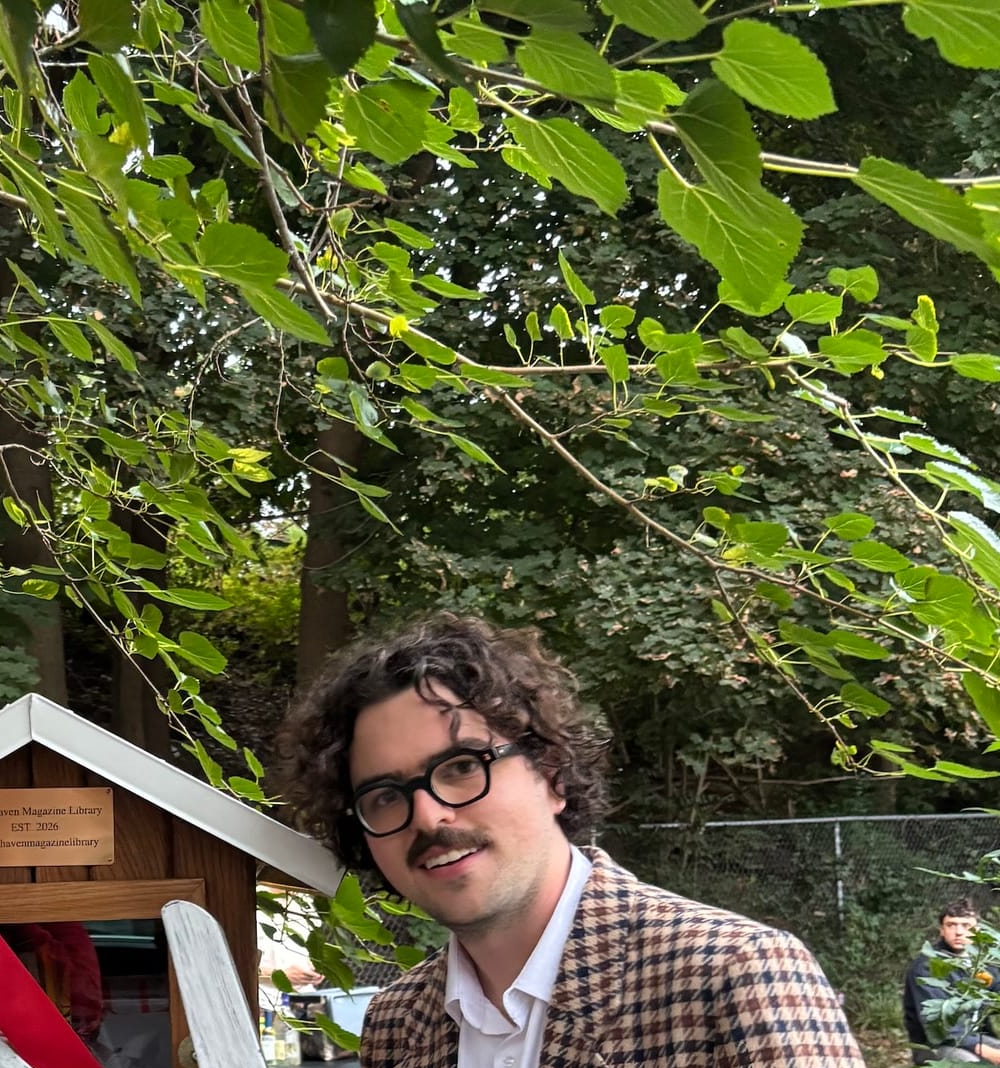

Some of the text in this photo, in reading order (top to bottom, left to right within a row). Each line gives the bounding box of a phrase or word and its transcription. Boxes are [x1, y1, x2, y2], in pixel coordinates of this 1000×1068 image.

[22, 806, 66, 818] Magazine
[68, 805, 103, 817] Library
[36, 822, 59, 831] 2026
